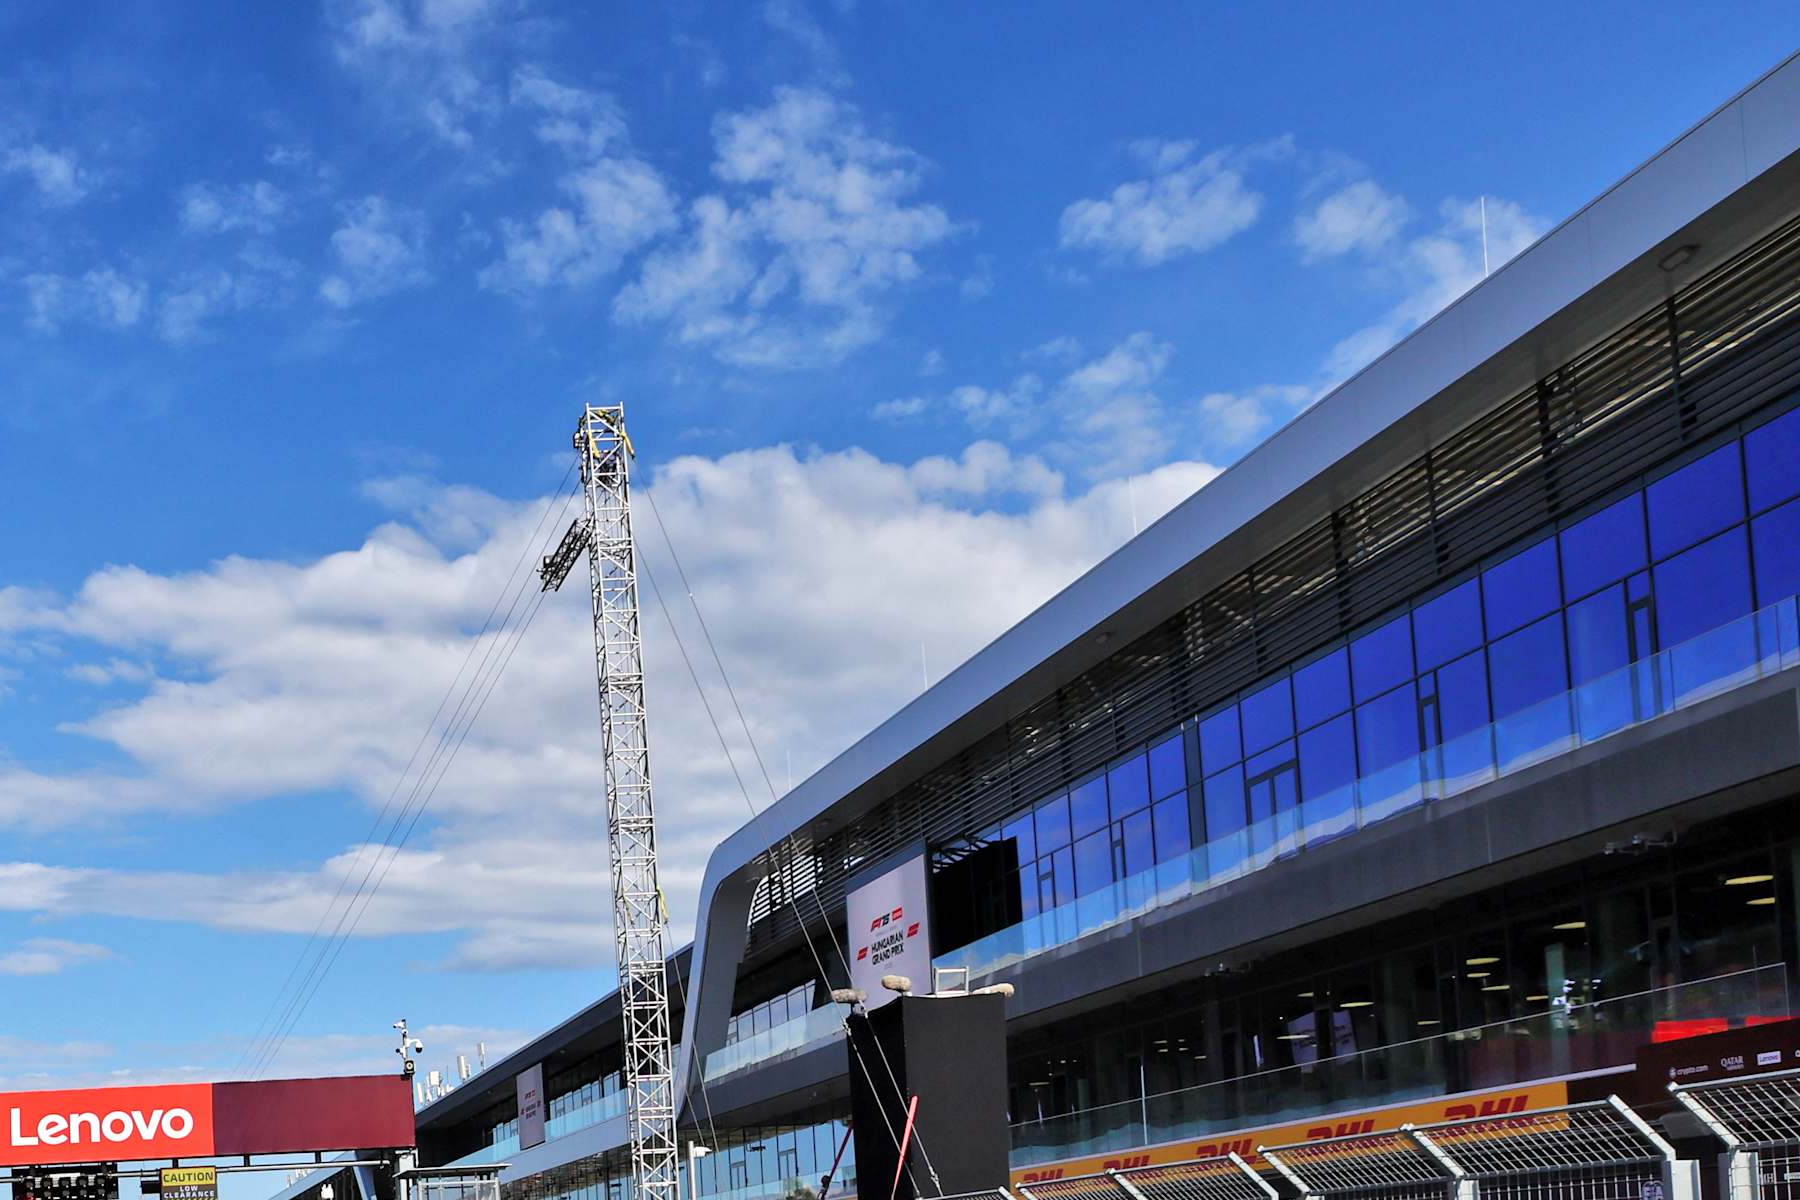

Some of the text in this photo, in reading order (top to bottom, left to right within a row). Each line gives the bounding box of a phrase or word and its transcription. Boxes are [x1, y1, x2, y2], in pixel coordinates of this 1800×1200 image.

[871, 930, 904, 954] HUNGARIAN
[871, 947, 891, 966] GRAND
[890, 942, 904, 957] PRIX
[1720, 1055, 1744, 1068] QATAR
[9, 1106, 194, 1147] Lenovo
[163, 1172, 214, 1183] CAUTION
[163, 1190, 215, 1199] CLEARANCE
[179, 1185, 199, 1193] LOW
